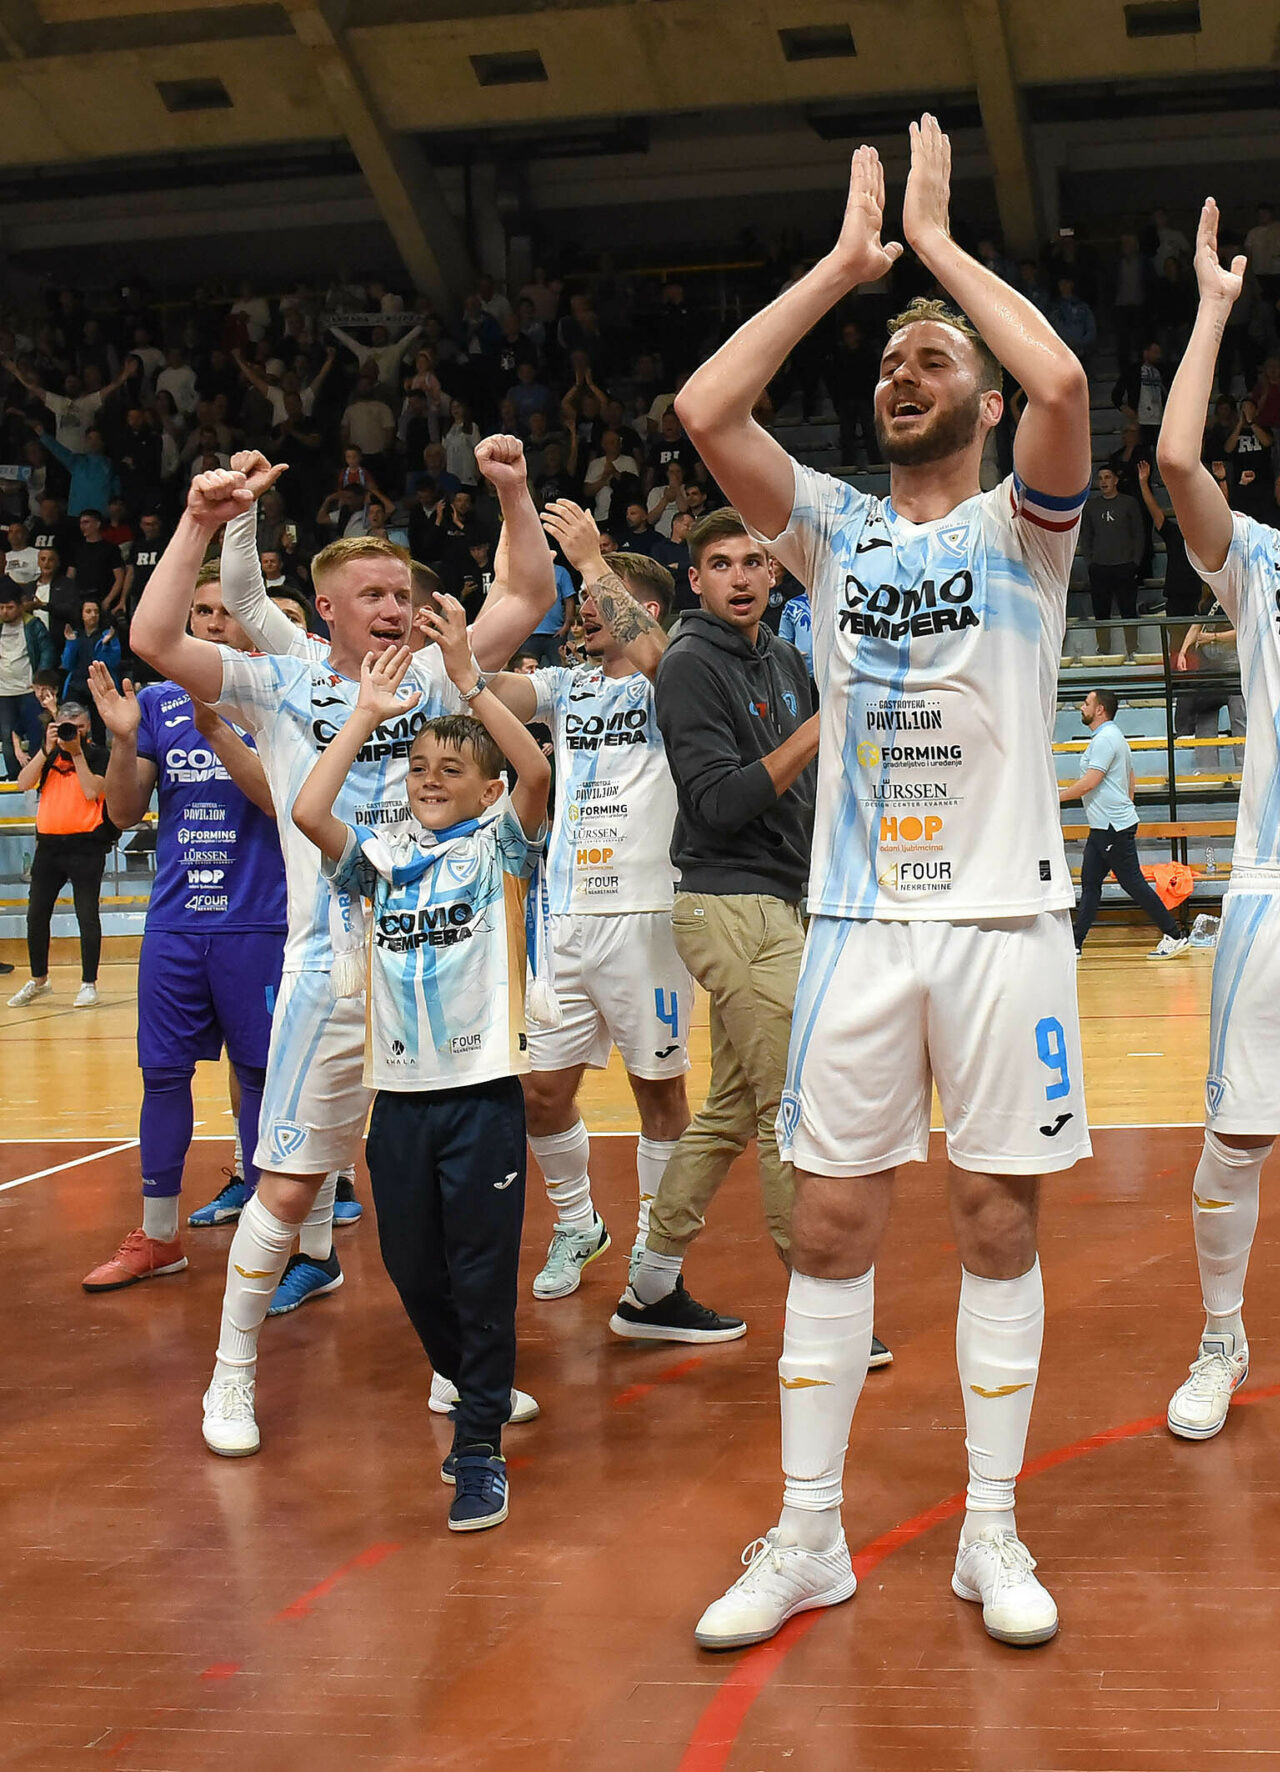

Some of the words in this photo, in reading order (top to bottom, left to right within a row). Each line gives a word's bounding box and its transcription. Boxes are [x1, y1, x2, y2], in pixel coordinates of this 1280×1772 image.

[1238, 435, 1262, 453] RI
[34, 534, 55, 547] RI
[136, 551, 157, 566] RI
[845, 570, 973, 618] COMO
[838, 605, 980, 641] TEMPERA
[879, 700, 925, 709] GASTROTEKA
[565, 709, 647, 735] COMO
[881, 745, 962, 760] FORMING
[882, 759, 925, 769] graditeljstvo
[580, 804, 628, 816] FORMING
[190, 830, 236, 840] FORMING
[880, 815, 943, 842] HOP
[880, 844, 900, 852] odani
[576, 848, 614, 865] HOP
[187, 869, 225, 884] HOP
[901, 862, 951, 880] FOUR
[588, 876, 618, 888] FOUR
[900, 883, 951, 891] NEKRETNINE
[198, 895, 228, 905] FOUR
[379, 903, 473, 935] COMO
[376, 927, 473, 951] TEMPERA
[654, 988, 678, 1038] 4
[452, 1034, 481, 1047] FOUR
[1035, 1016, 1071, 1101] 9
